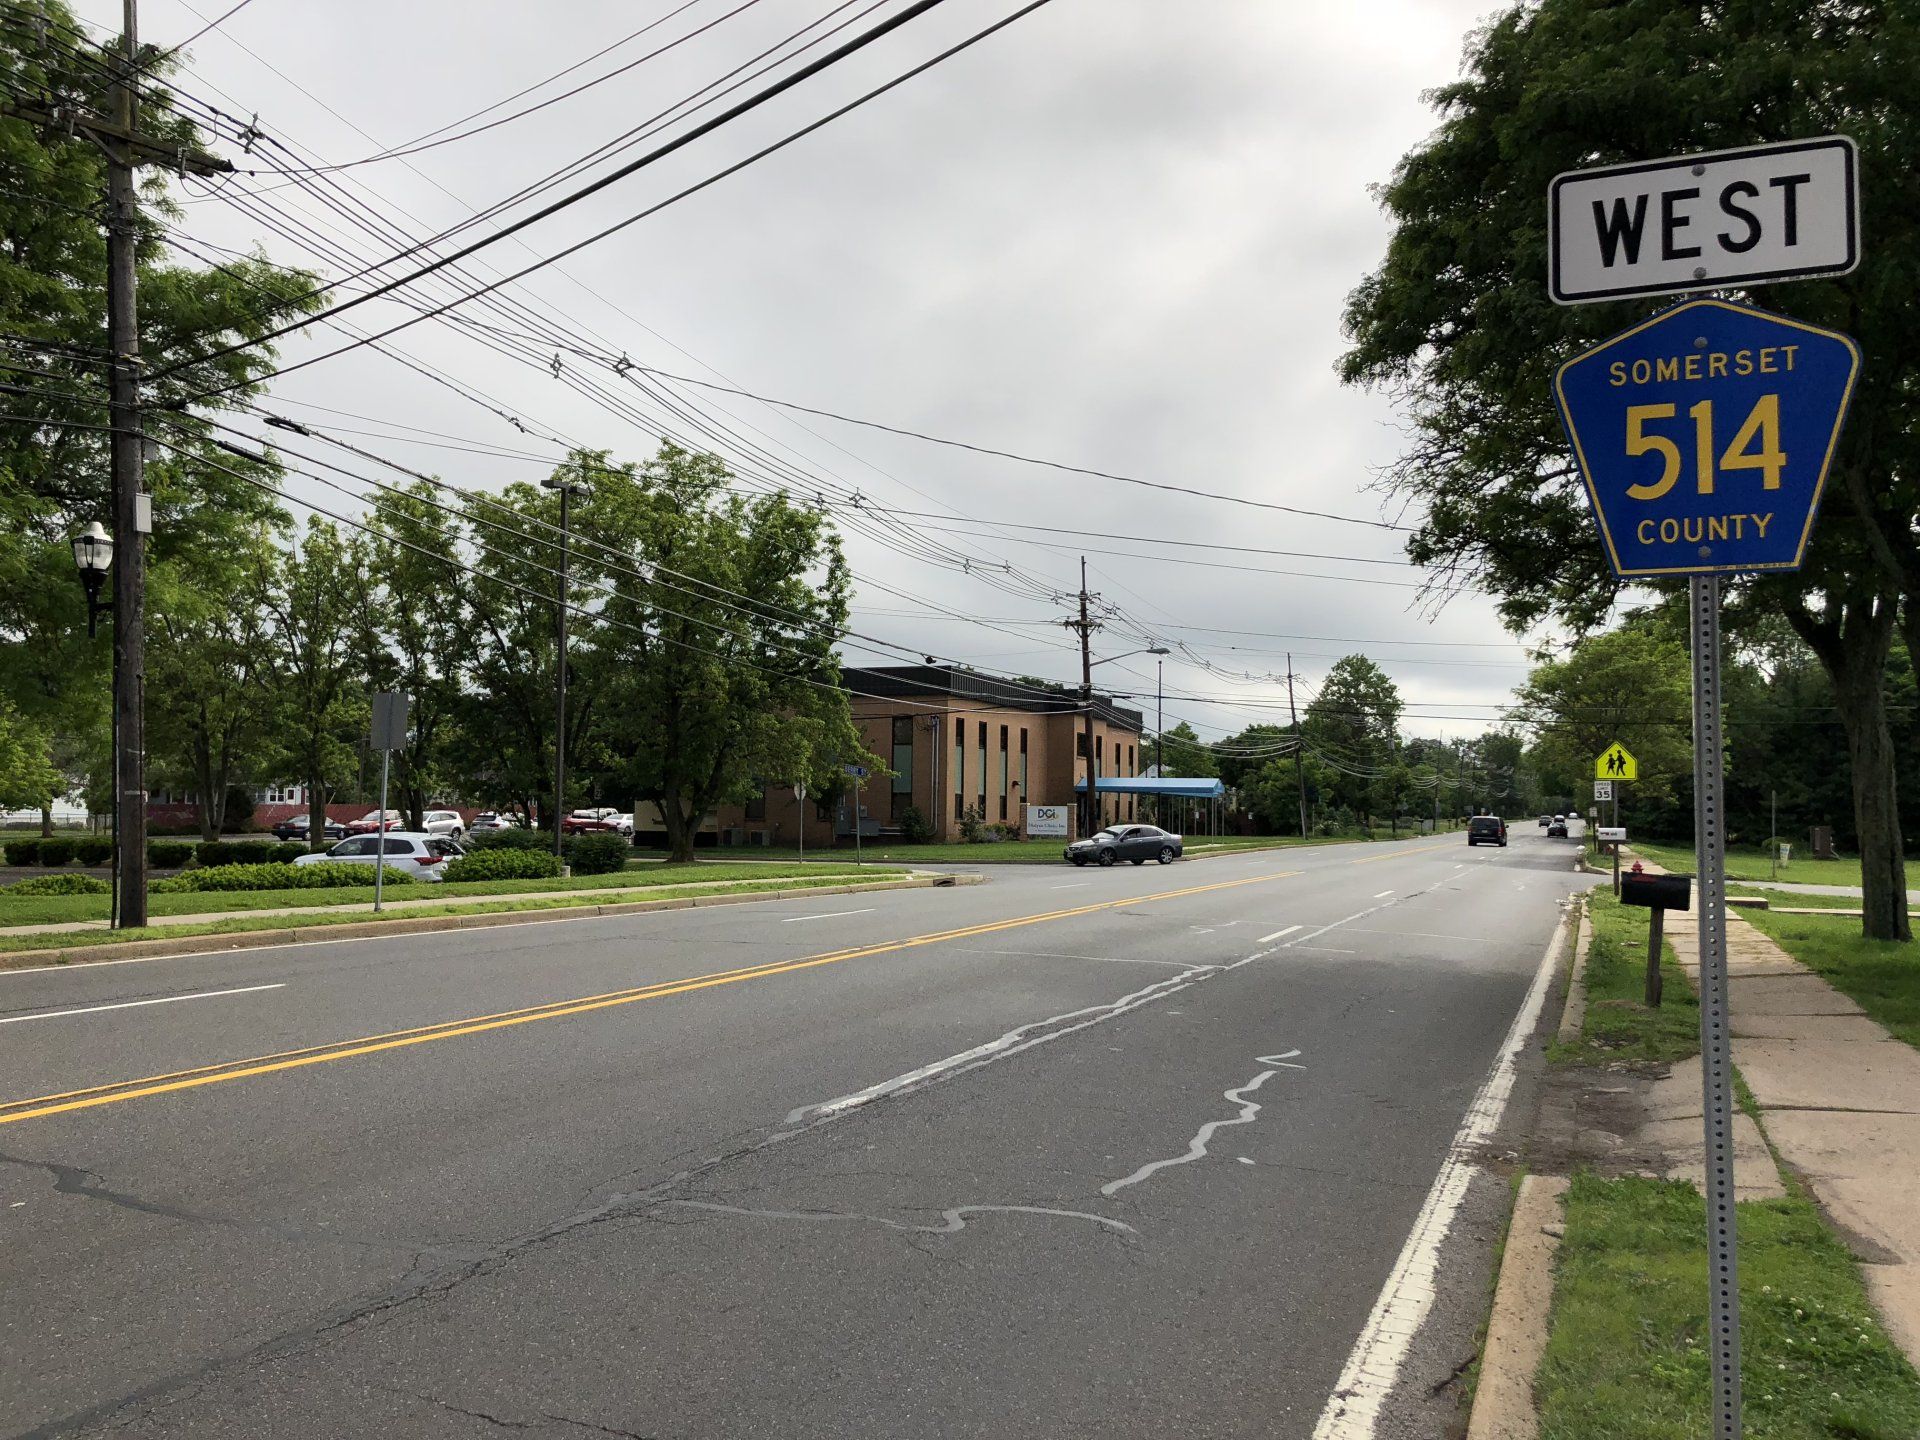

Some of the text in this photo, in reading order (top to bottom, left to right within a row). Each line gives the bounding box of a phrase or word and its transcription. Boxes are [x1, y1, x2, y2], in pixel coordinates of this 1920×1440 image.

[1592, 173, 1811, 268] WEST
[1609, 345, 1799, 387] SOMERSET
[1625, 394, 1787, 500] 514
[1637, 513, 1774, 545] COUNTY
